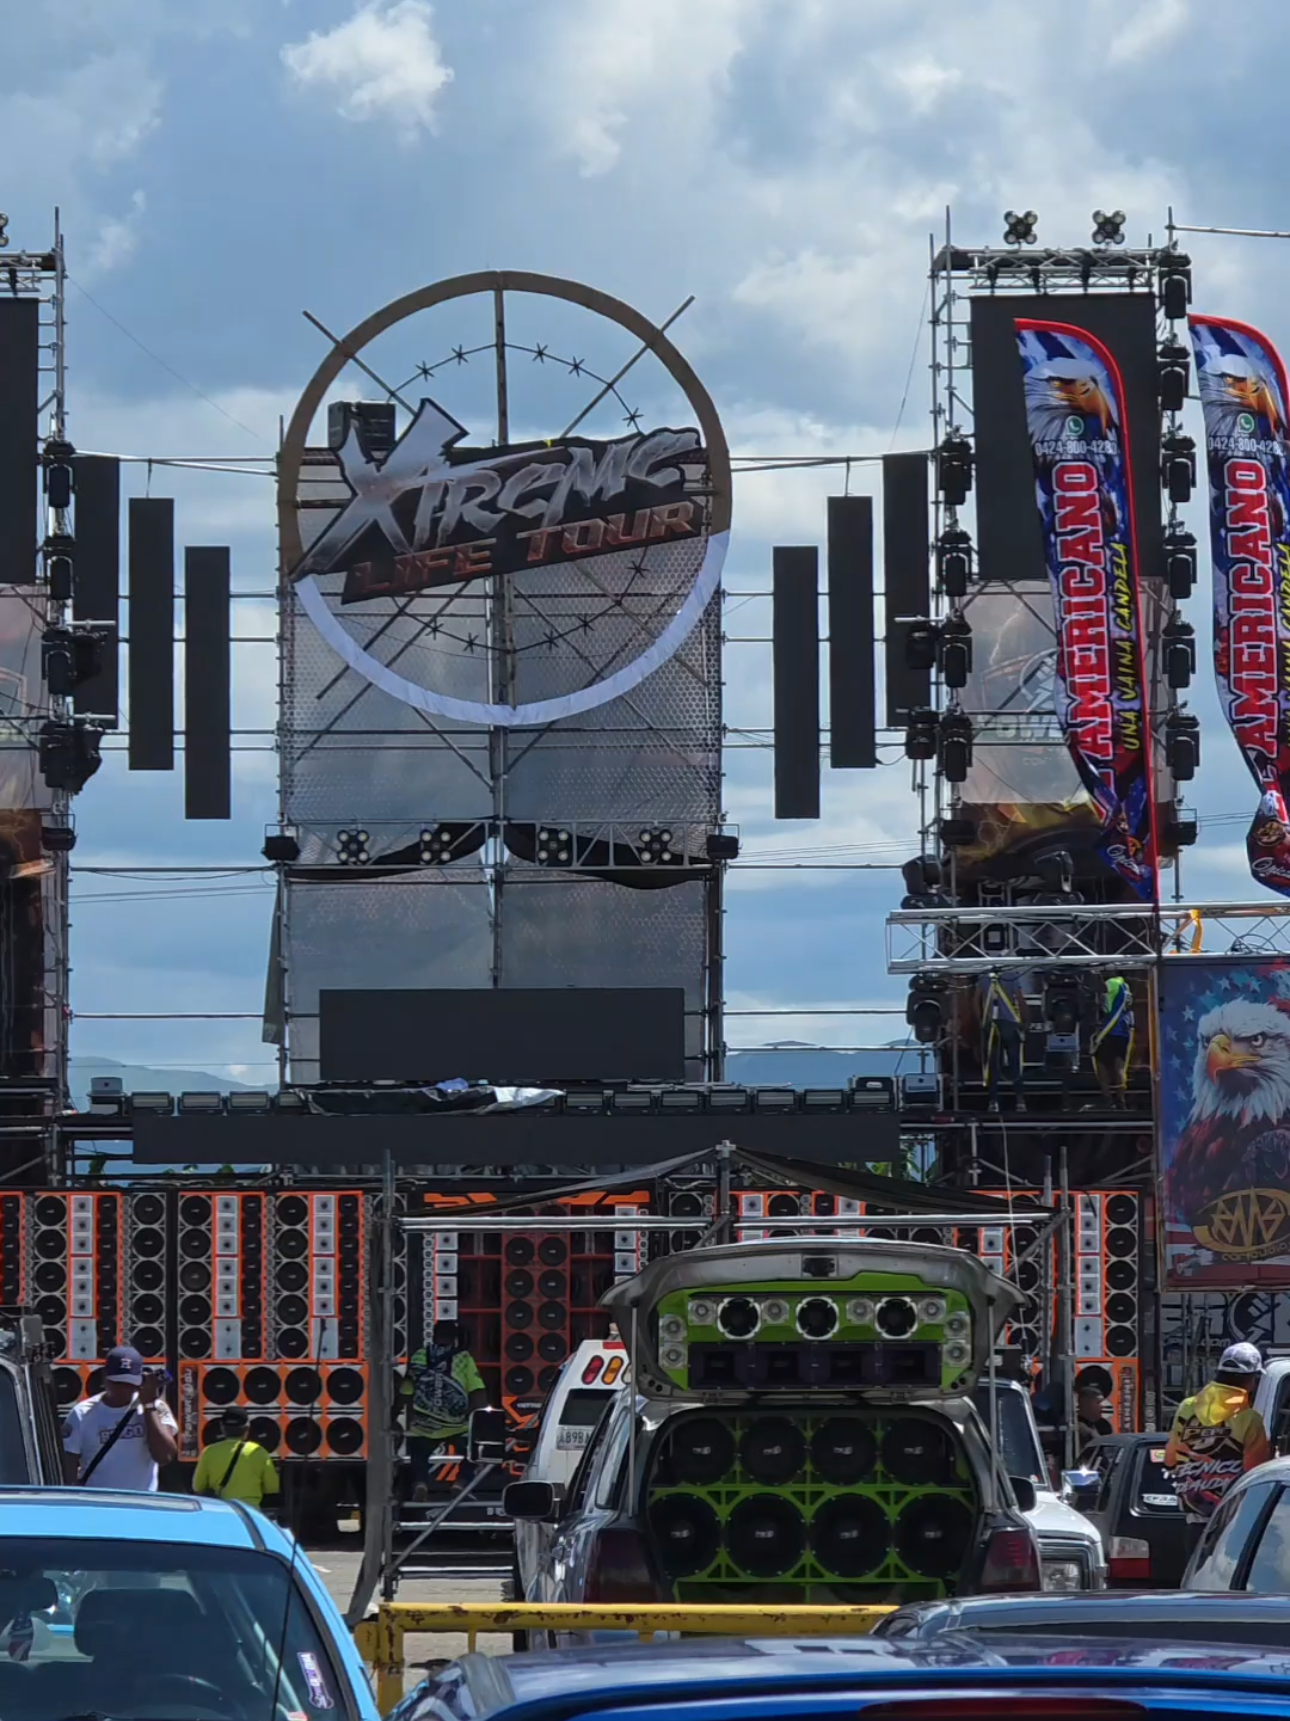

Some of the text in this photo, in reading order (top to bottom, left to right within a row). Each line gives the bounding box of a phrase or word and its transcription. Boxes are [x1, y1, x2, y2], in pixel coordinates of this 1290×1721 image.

[350, 500, 698, 595] LIFE TOUR
[1052, 460, 1113, 760] AMERICANO
[1110, 543, 1140, 750] UNA VAINA CANDELA
[1224, 458, 1278, 758] AMERICANO
